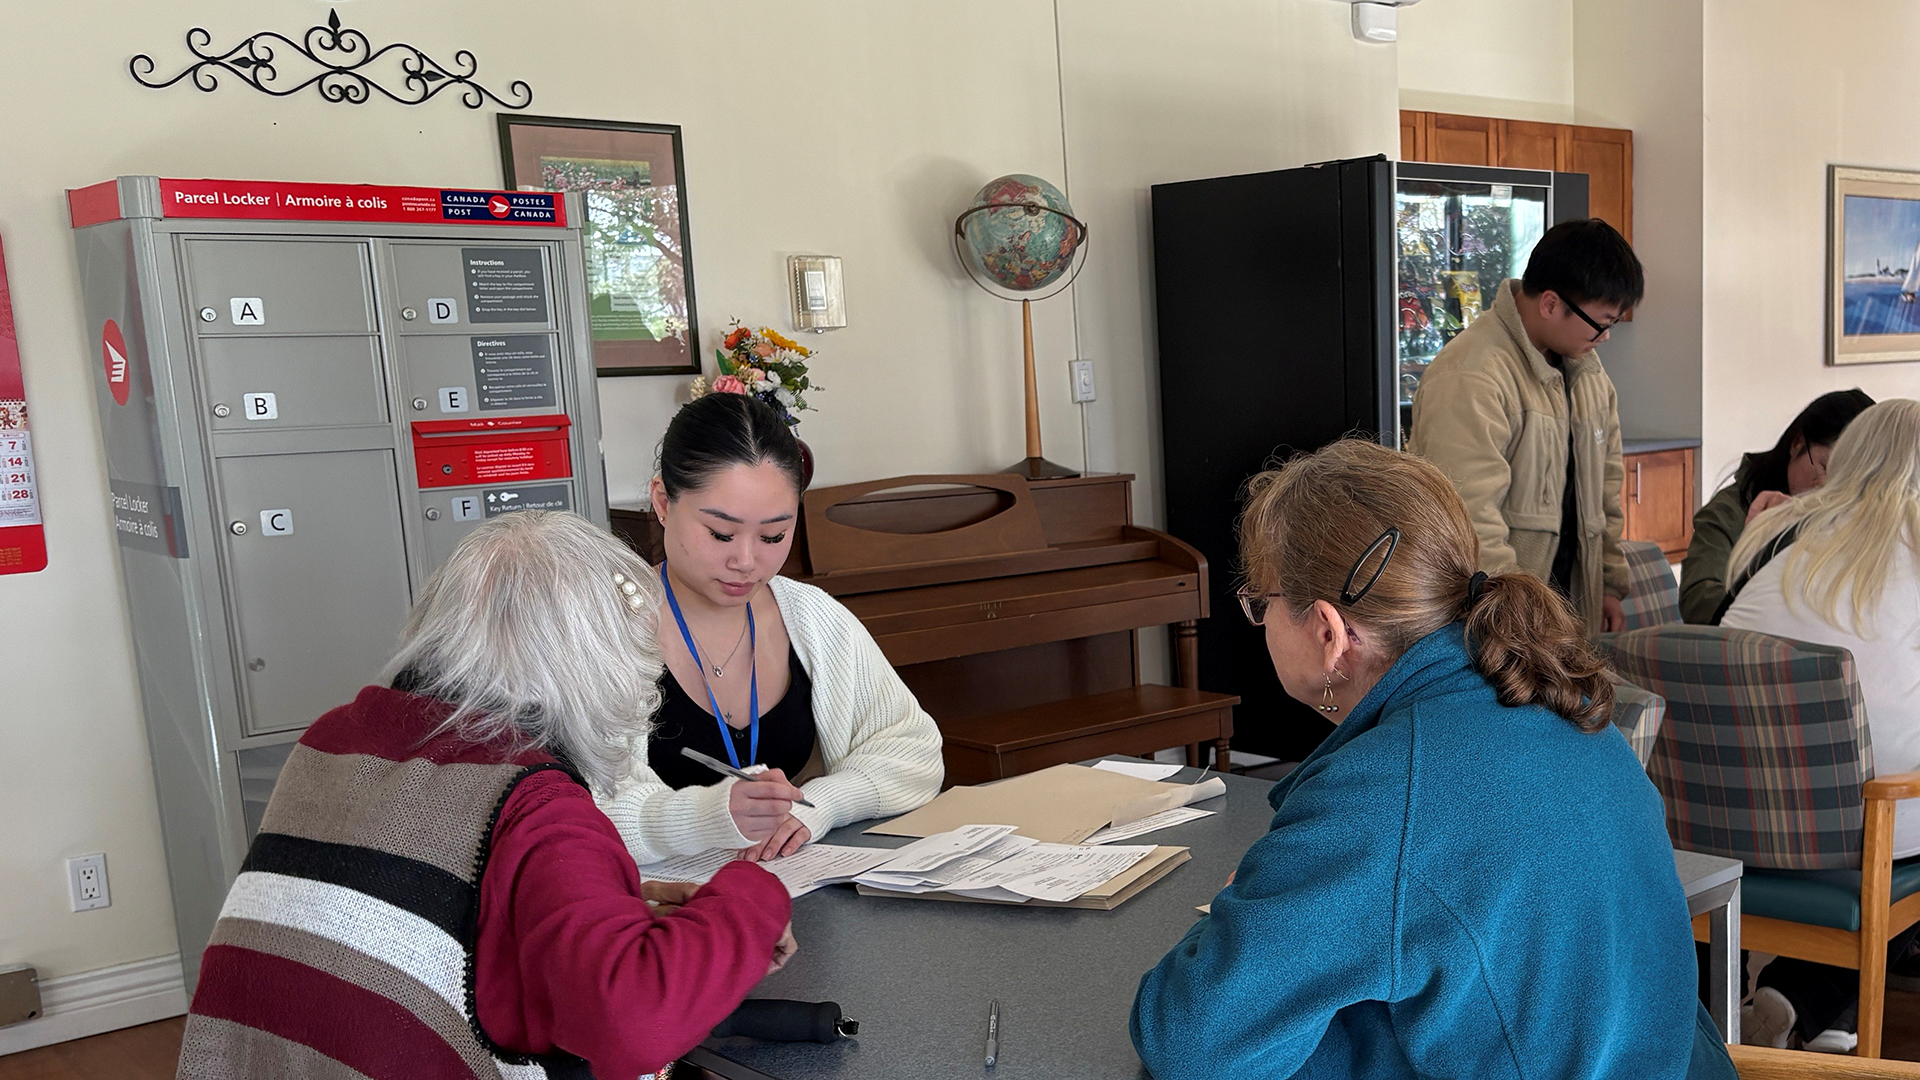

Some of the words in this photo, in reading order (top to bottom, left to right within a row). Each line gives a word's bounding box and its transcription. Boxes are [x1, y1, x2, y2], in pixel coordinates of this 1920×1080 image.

[174, 190, 218, 204] Parcel
[223, 192, 270, 206] Locker
[286, 194, 342, 208] Armoire
[345, 196, 354, 208] à
[358, 196, 388, 209] colis
[446, 195, 486, 204] CANADA
[512, 198, 546, 206] POSTES
[514, 210, 551, 218] CANADA
[240, 302, 258, 320] A
[436, 302, 450, 320] D
[254, 397, 268, 416] B
[448, 392, 460, 409] E
[8, 441, 16, 450] 7
[8, 457, 23, 466] 14
[11, 474, 26, 483] 21
[12, 490, 29, 499] 28
[129, 495, 149, 514] Locker
[462, 500, 471, 517] F
[144, 520, 158, 538] colis
[270, 514, 286, 531] C
